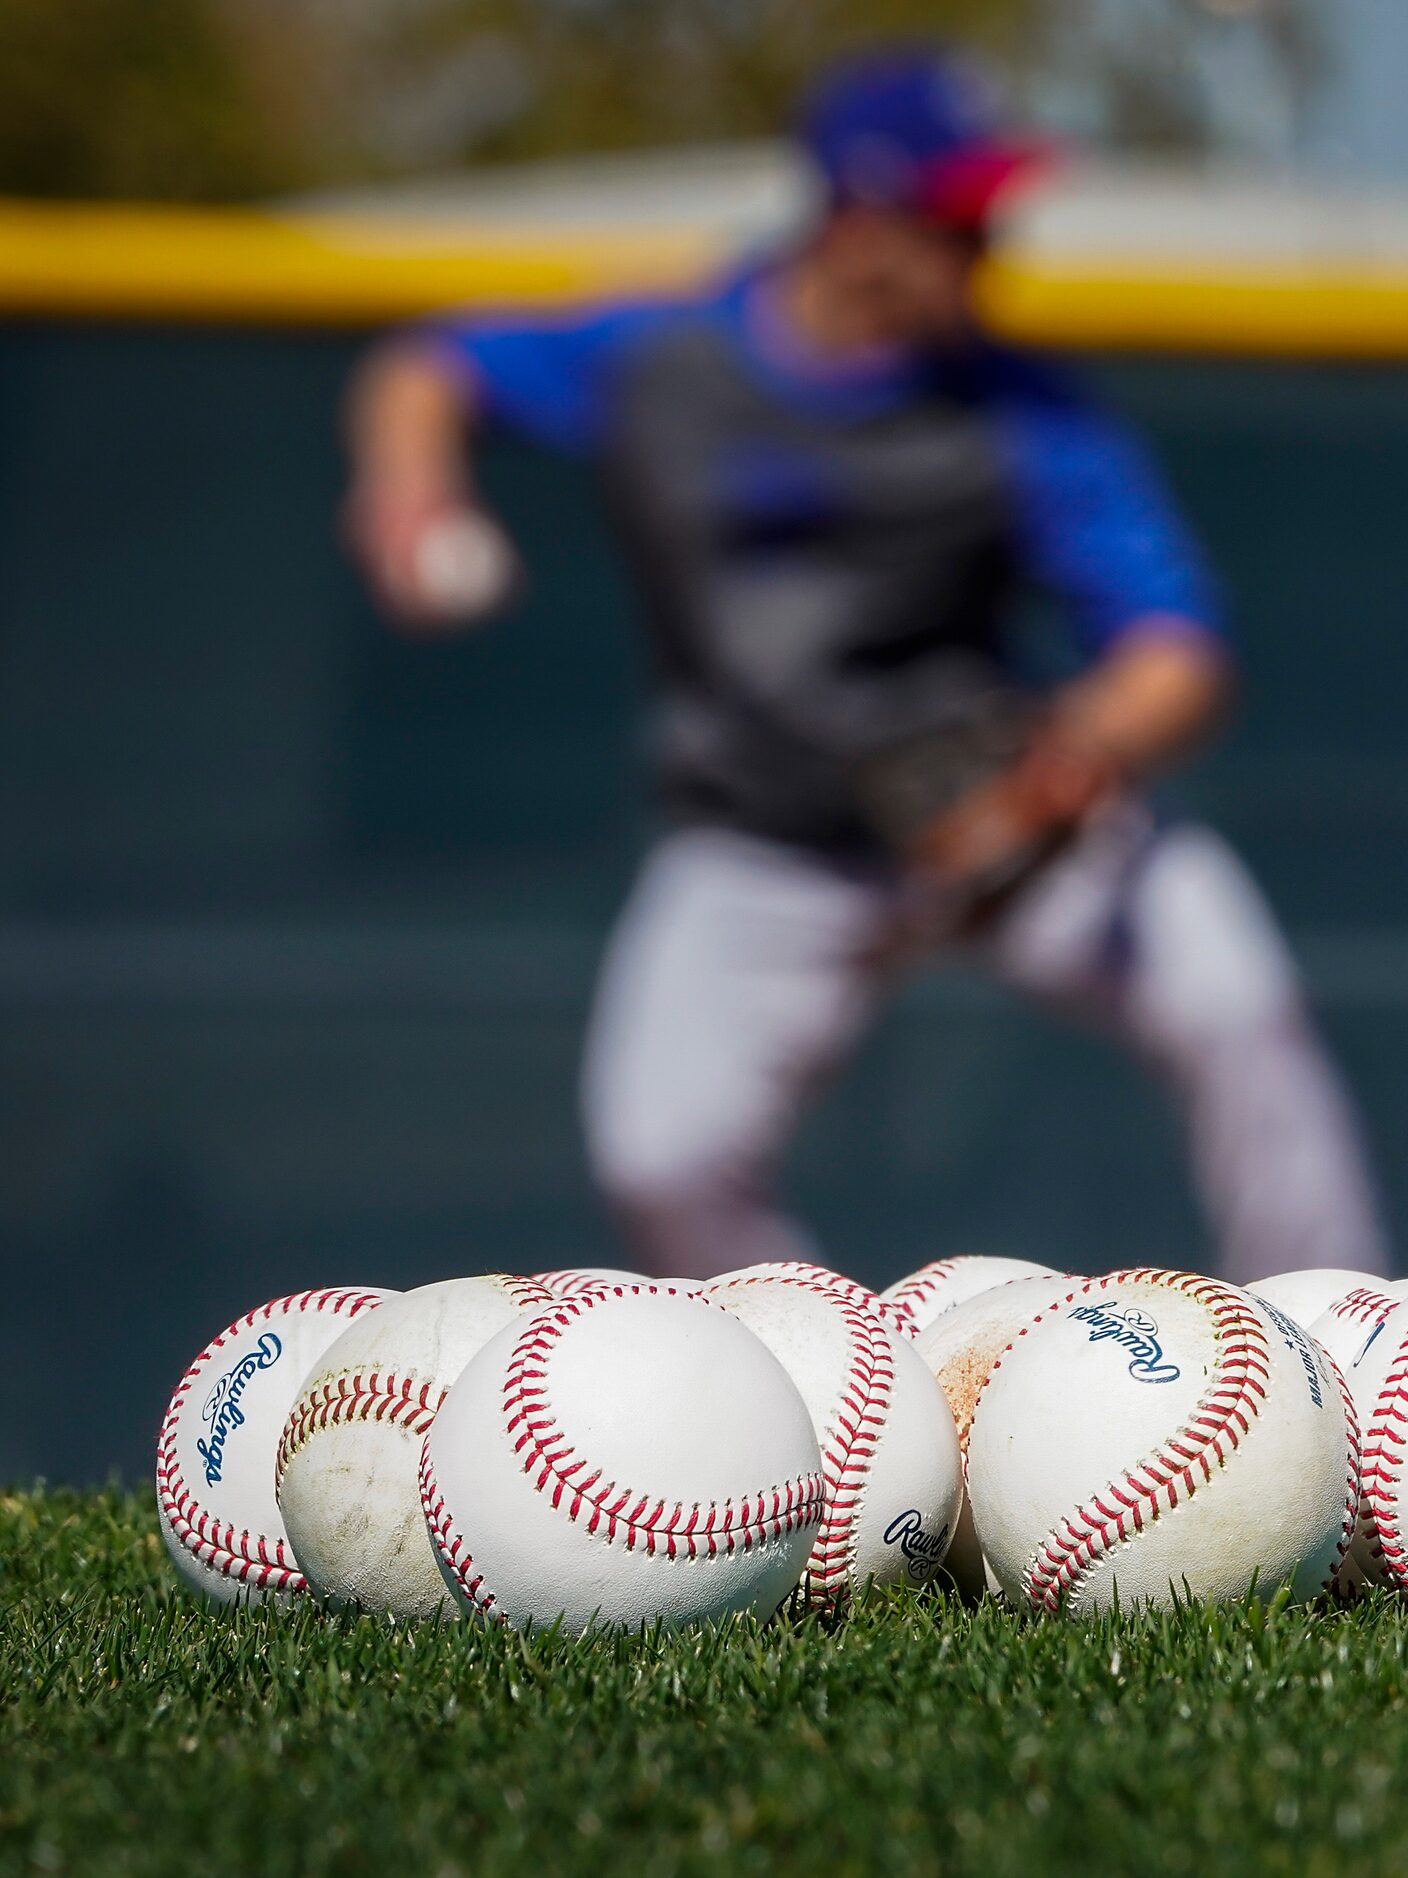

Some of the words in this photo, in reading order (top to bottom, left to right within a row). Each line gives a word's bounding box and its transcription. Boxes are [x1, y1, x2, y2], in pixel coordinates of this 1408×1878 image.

[1067, 1300, 1181, 1384] Rawlings
[1298, 1348, 1323, 1409] MAJOR
[197, 1332, 282, 1489] Rawlings
